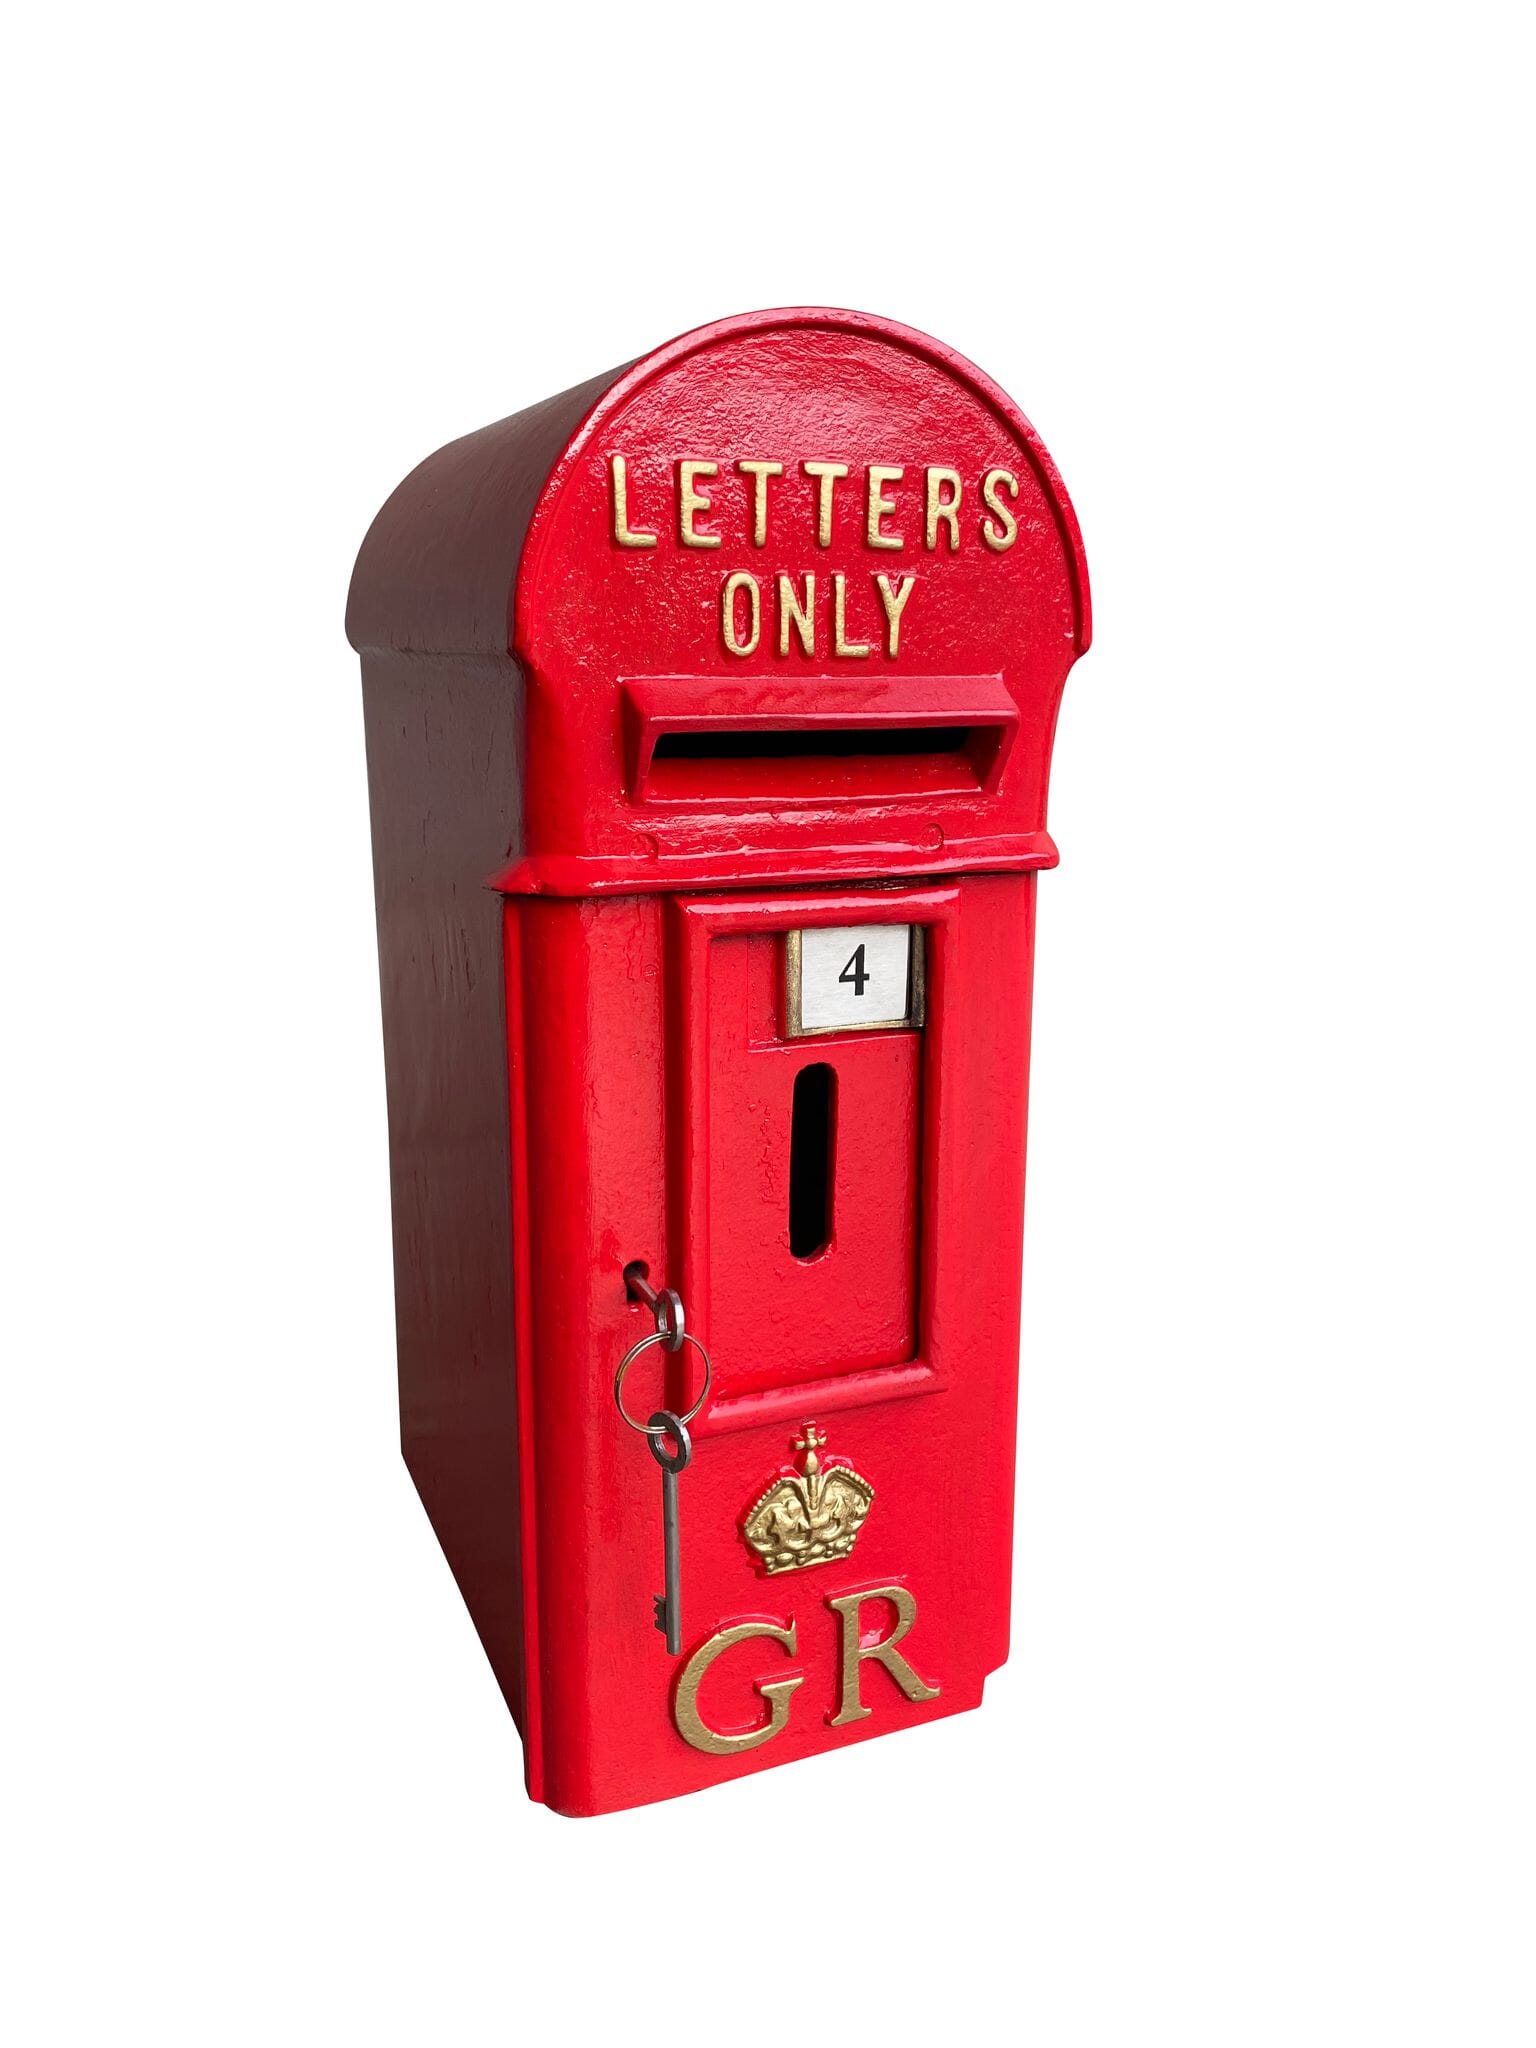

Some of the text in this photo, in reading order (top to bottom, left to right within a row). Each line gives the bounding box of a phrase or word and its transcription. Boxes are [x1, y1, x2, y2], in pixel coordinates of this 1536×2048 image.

[613, 455, 1019, 551] LETTERS
[722, 571, 916, 657] ONLY
[838, 943, 870, 996] 4
[675, 1586, 941, 1755] GR
